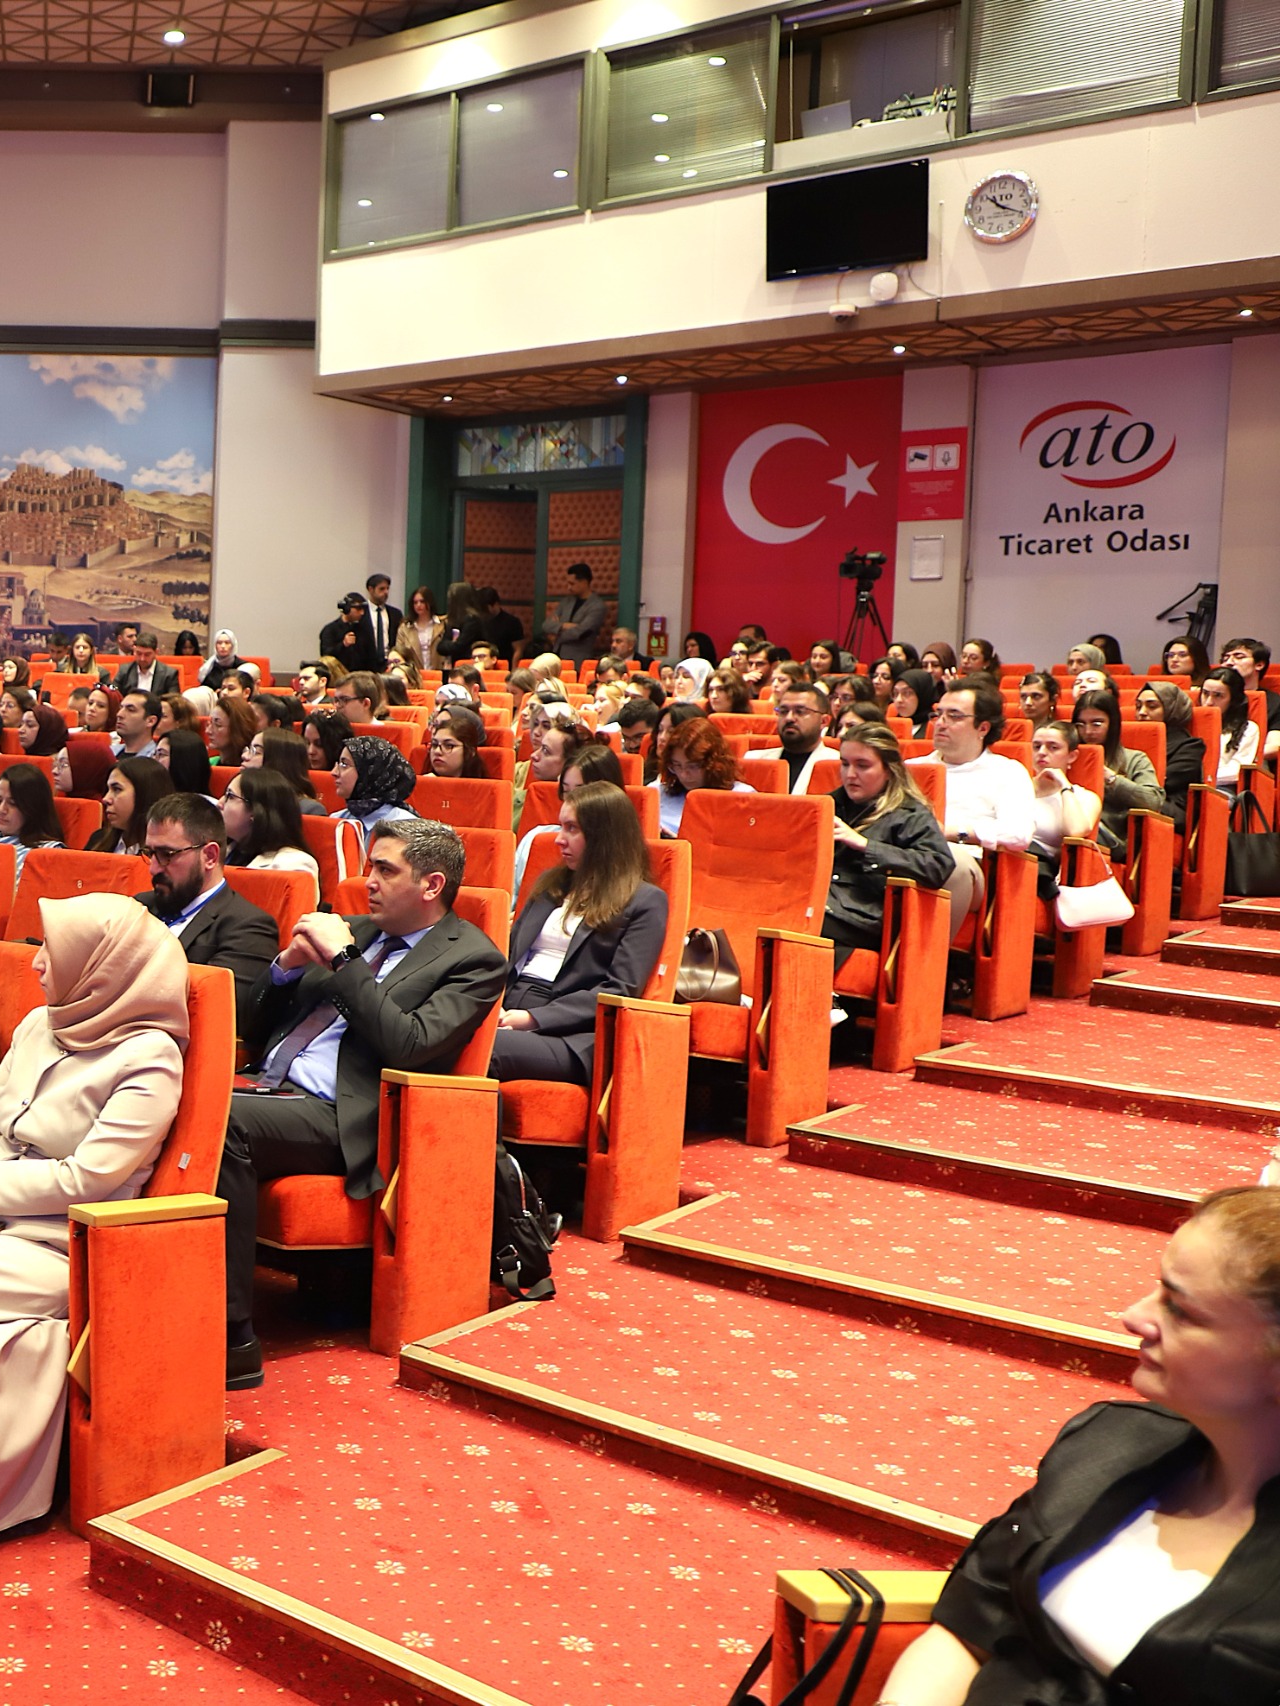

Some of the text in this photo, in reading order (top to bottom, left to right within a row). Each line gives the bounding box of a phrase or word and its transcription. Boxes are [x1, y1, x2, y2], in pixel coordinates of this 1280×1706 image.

[990, 185, 996, 193] 11
[999, 181, 1007, 189] 12
[1019, 189, 1025, 197] 2
[1022, 199, 1028, 207] 3
[975, 205, 982, 214] 9
[978, 216, 984, 224] 8
[1008, 220, 1014, 228] 5
[988, 223, 994, 231] 7
[997, 224, 1003, 232] 6
[1039, 414, 1155, 469] ato
[1043, 499, 1145, 524] Ankara
[999, 527, 1190, 556] Ticaret Odası
[442, 800, 450, 808] 11
[749, 817, 755, 826] 9
[77, 879, 83, 889] 8
